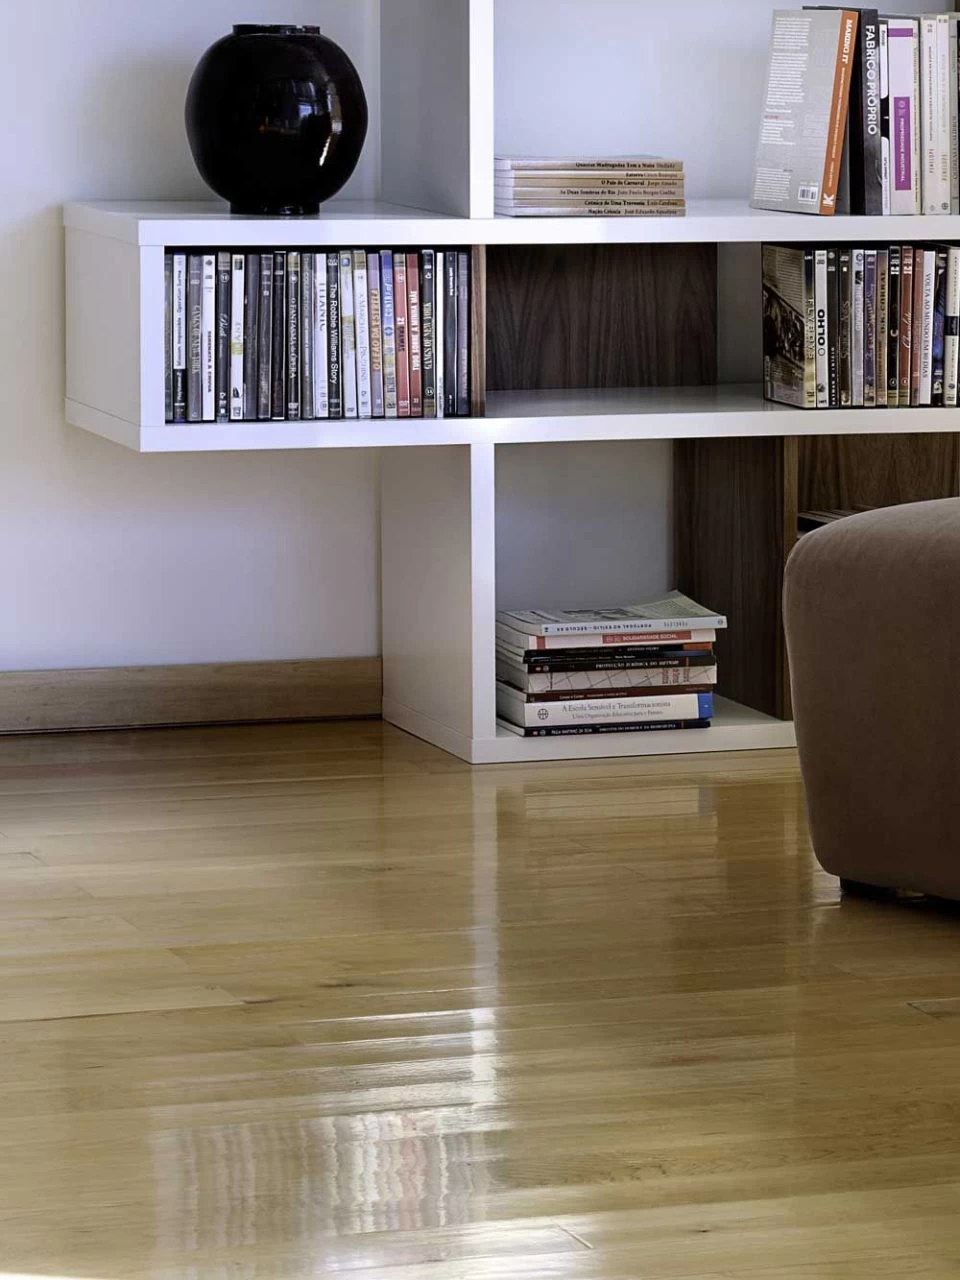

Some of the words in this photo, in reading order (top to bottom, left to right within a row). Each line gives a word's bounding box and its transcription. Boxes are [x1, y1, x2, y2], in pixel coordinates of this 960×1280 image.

[843, 19, 853, 53] MAKING
[865, 25, 876, 80] FABRICO
[329, 283, 337, 298] The
[329, 300, 338, 327] Robbie
[924, 299, 930, 310] AO
[806, 298, 815, 359] FLYBOYS
[817, 309, 825, 346] OLHO
[330, 329, 338, 361] Williams
[923, 340, 930, 352] EM
[329, 363, 338, 384] Story
[568, 704, 586, 712] Escola
